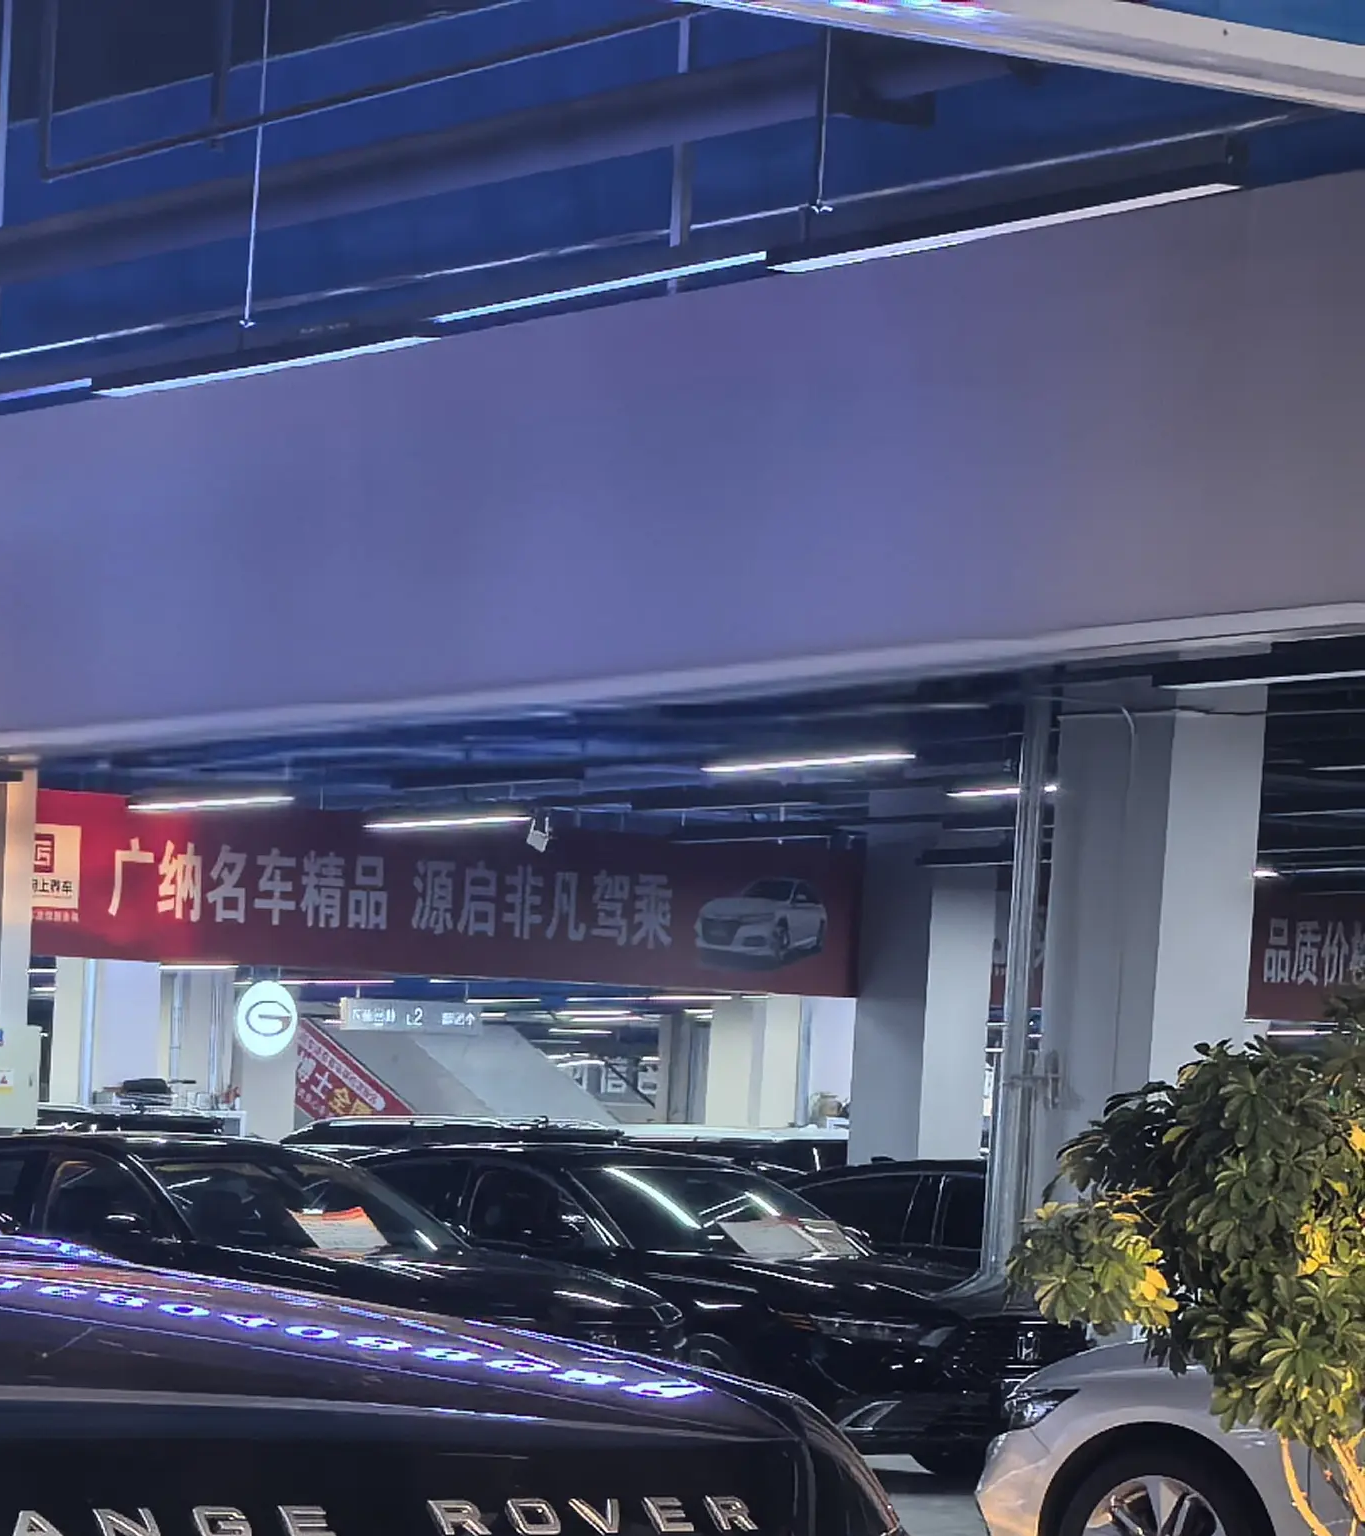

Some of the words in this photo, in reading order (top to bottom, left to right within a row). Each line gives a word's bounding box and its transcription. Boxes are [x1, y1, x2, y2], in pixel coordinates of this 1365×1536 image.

[107, 838, 388, 930] 广纳名车精品
[410, 858, 673, 950] 源启非凡驾乘
[426, 1494, 761, 1536] ROVER
